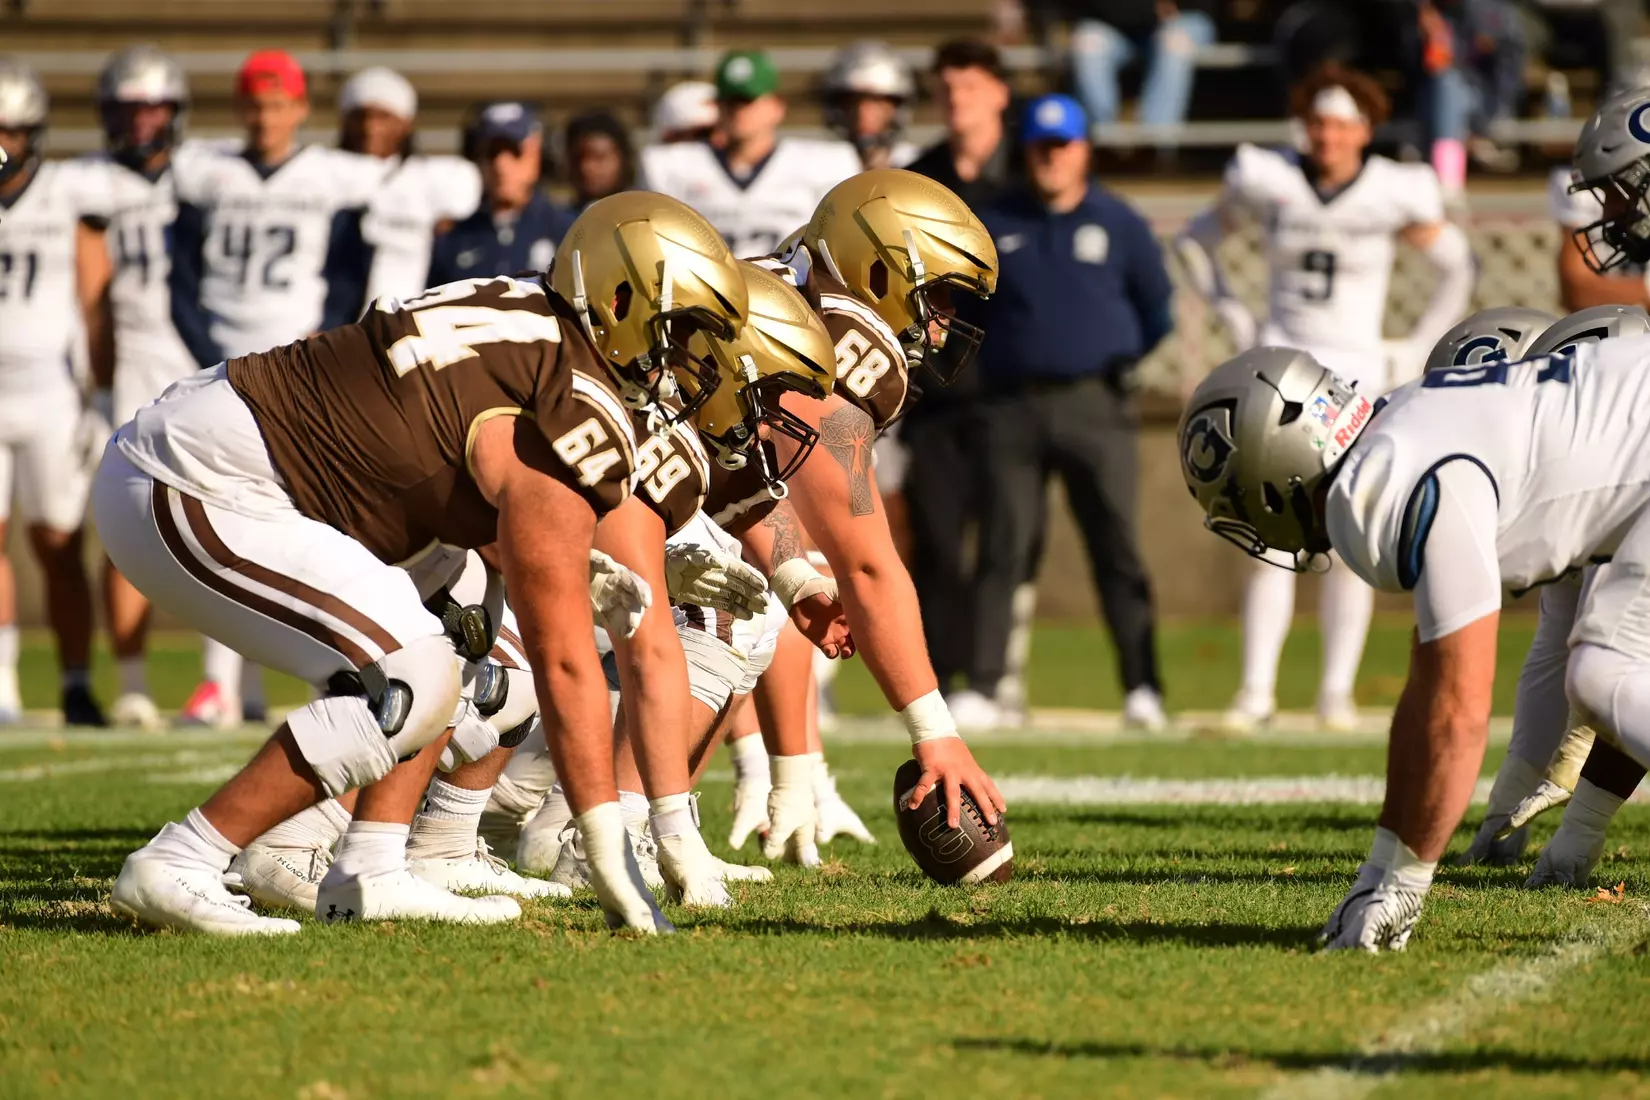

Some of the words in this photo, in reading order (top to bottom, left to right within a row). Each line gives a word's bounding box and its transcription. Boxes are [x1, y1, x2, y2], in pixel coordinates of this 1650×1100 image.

[222, 223, 296, 289] 42
[1301, 249, 1335, 303] 9
[834, 328, 891, 398] 68
[552, 417, 622, 487] 64
[638, 434, 691, 503] 69
[1183, 414, 1238, 484] G
